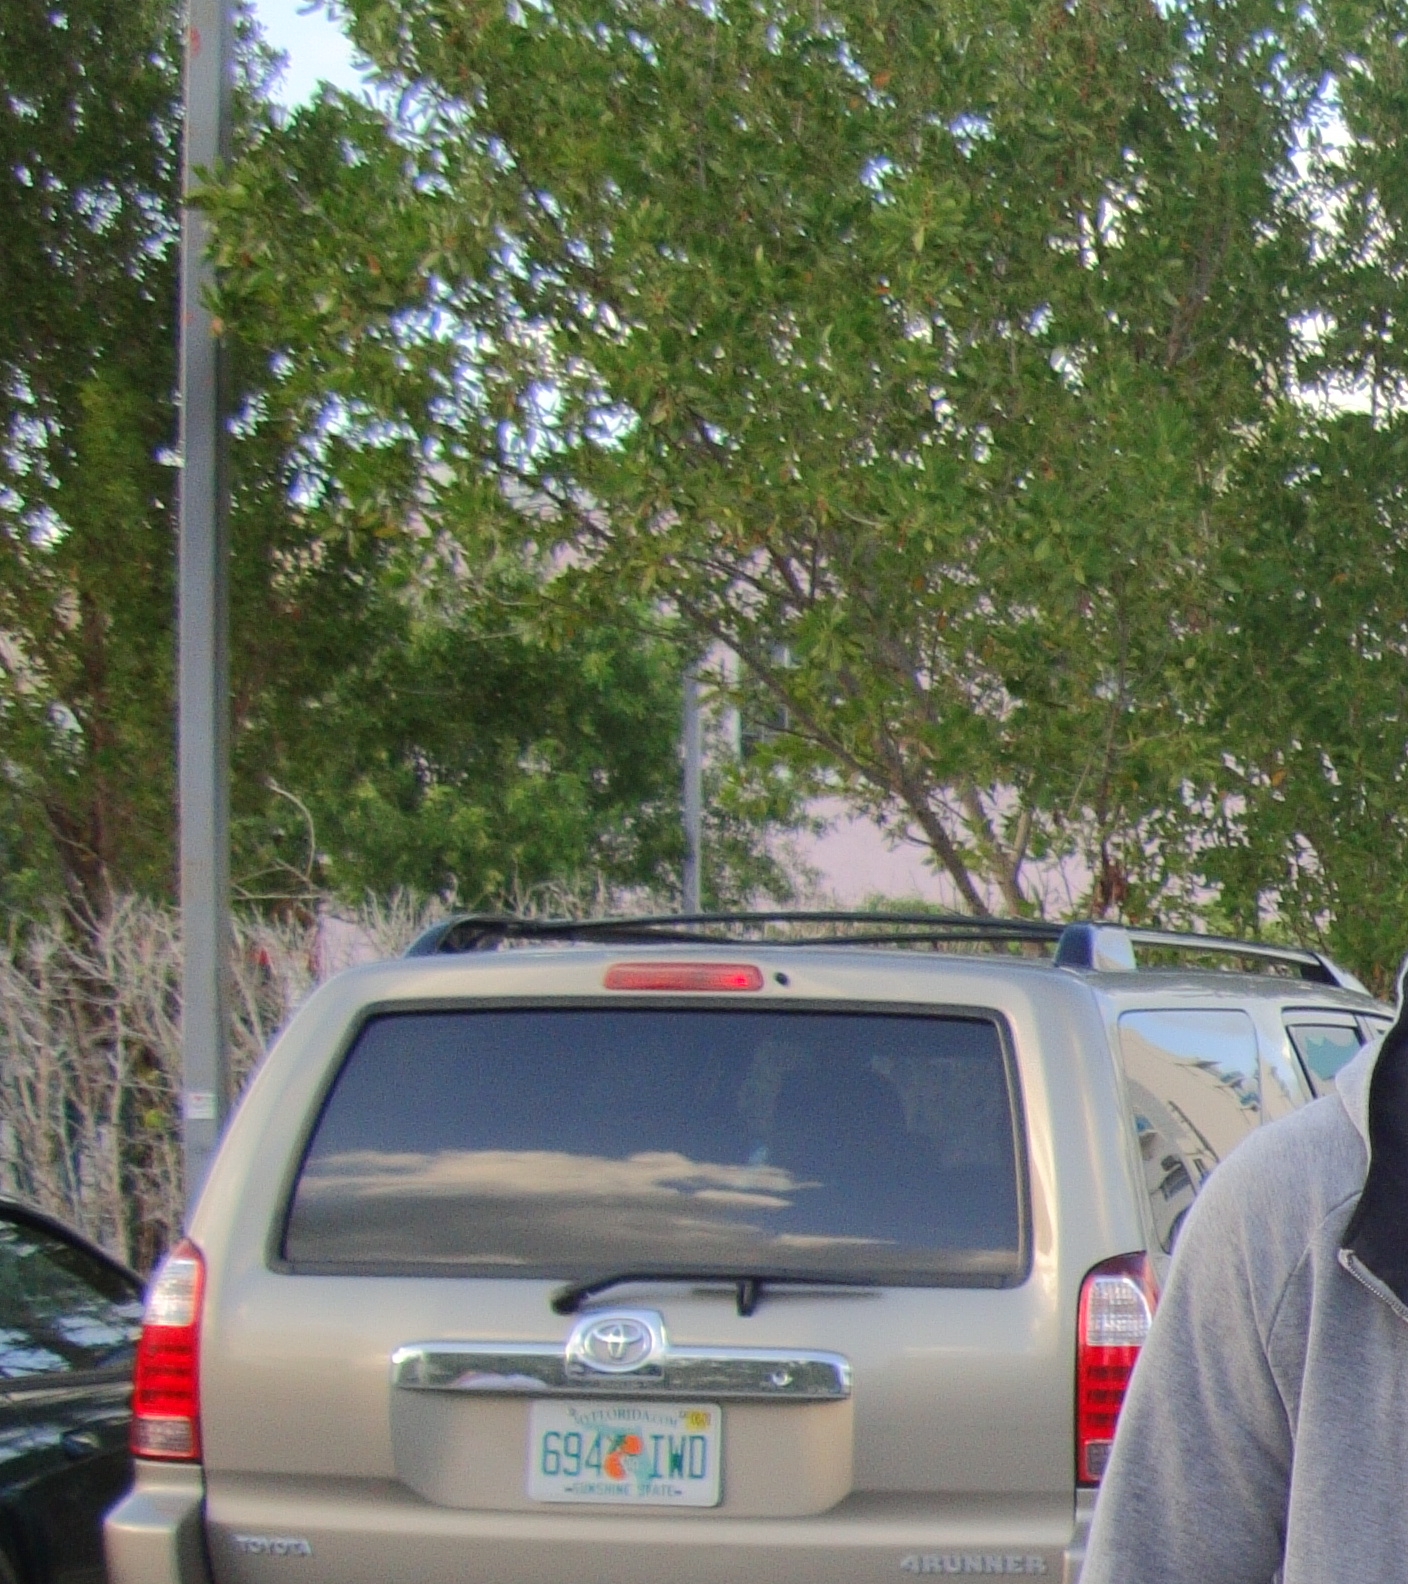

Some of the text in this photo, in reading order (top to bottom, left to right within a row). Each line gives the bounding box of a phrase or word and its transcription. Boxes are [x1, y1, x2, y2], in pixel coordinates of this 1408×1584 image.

[542, 1431, 707, 1480] 694 IWD
[230, 1534, 312, 1555] TOYOTA
[900, 1553, 1048, 1575] 4RUNNER
